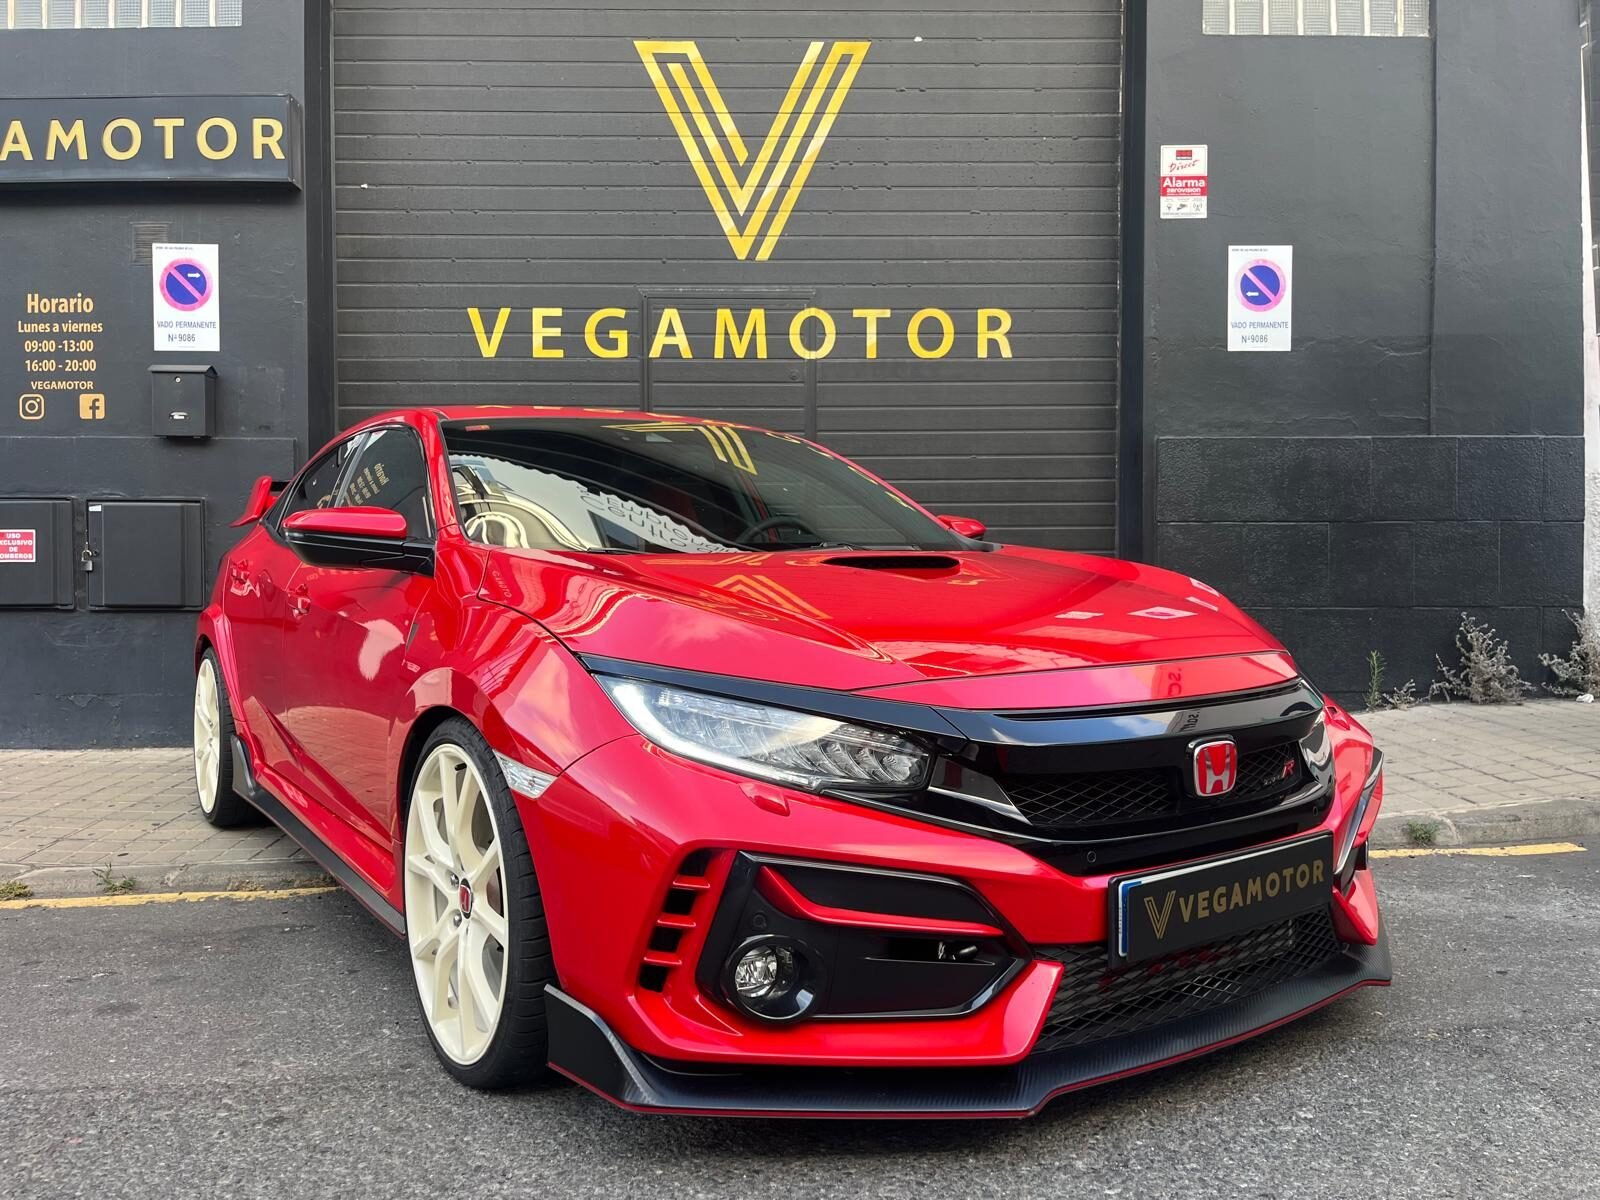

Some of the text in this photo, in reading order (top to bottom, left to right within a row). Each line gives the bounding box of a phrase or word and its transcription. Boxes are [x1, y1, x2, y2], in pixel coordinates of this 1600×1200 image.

[0, 117, 285, 161] AMOTOR
[1163, 177, 1205, 188] Alarma
[27, 293, 94, 313] Horario
[18, 320, 103, 333] Lunes a viernes
[156, 321, 217, 329] VADO PERMANENTE
[1231, 321, 1289, 329] VADO PERMANENTE
[467, 307, 1014, 359] VEGAMOTOR
[24, 340, 56, 352] 09:00
[25, 360, 56, 372] 16:00
[64, 360, 97, 372] 20:00
[31, 381, 94, 390] VEGAMOTOR
[1179, 859, 1325, 923] VEGAMOTOR
